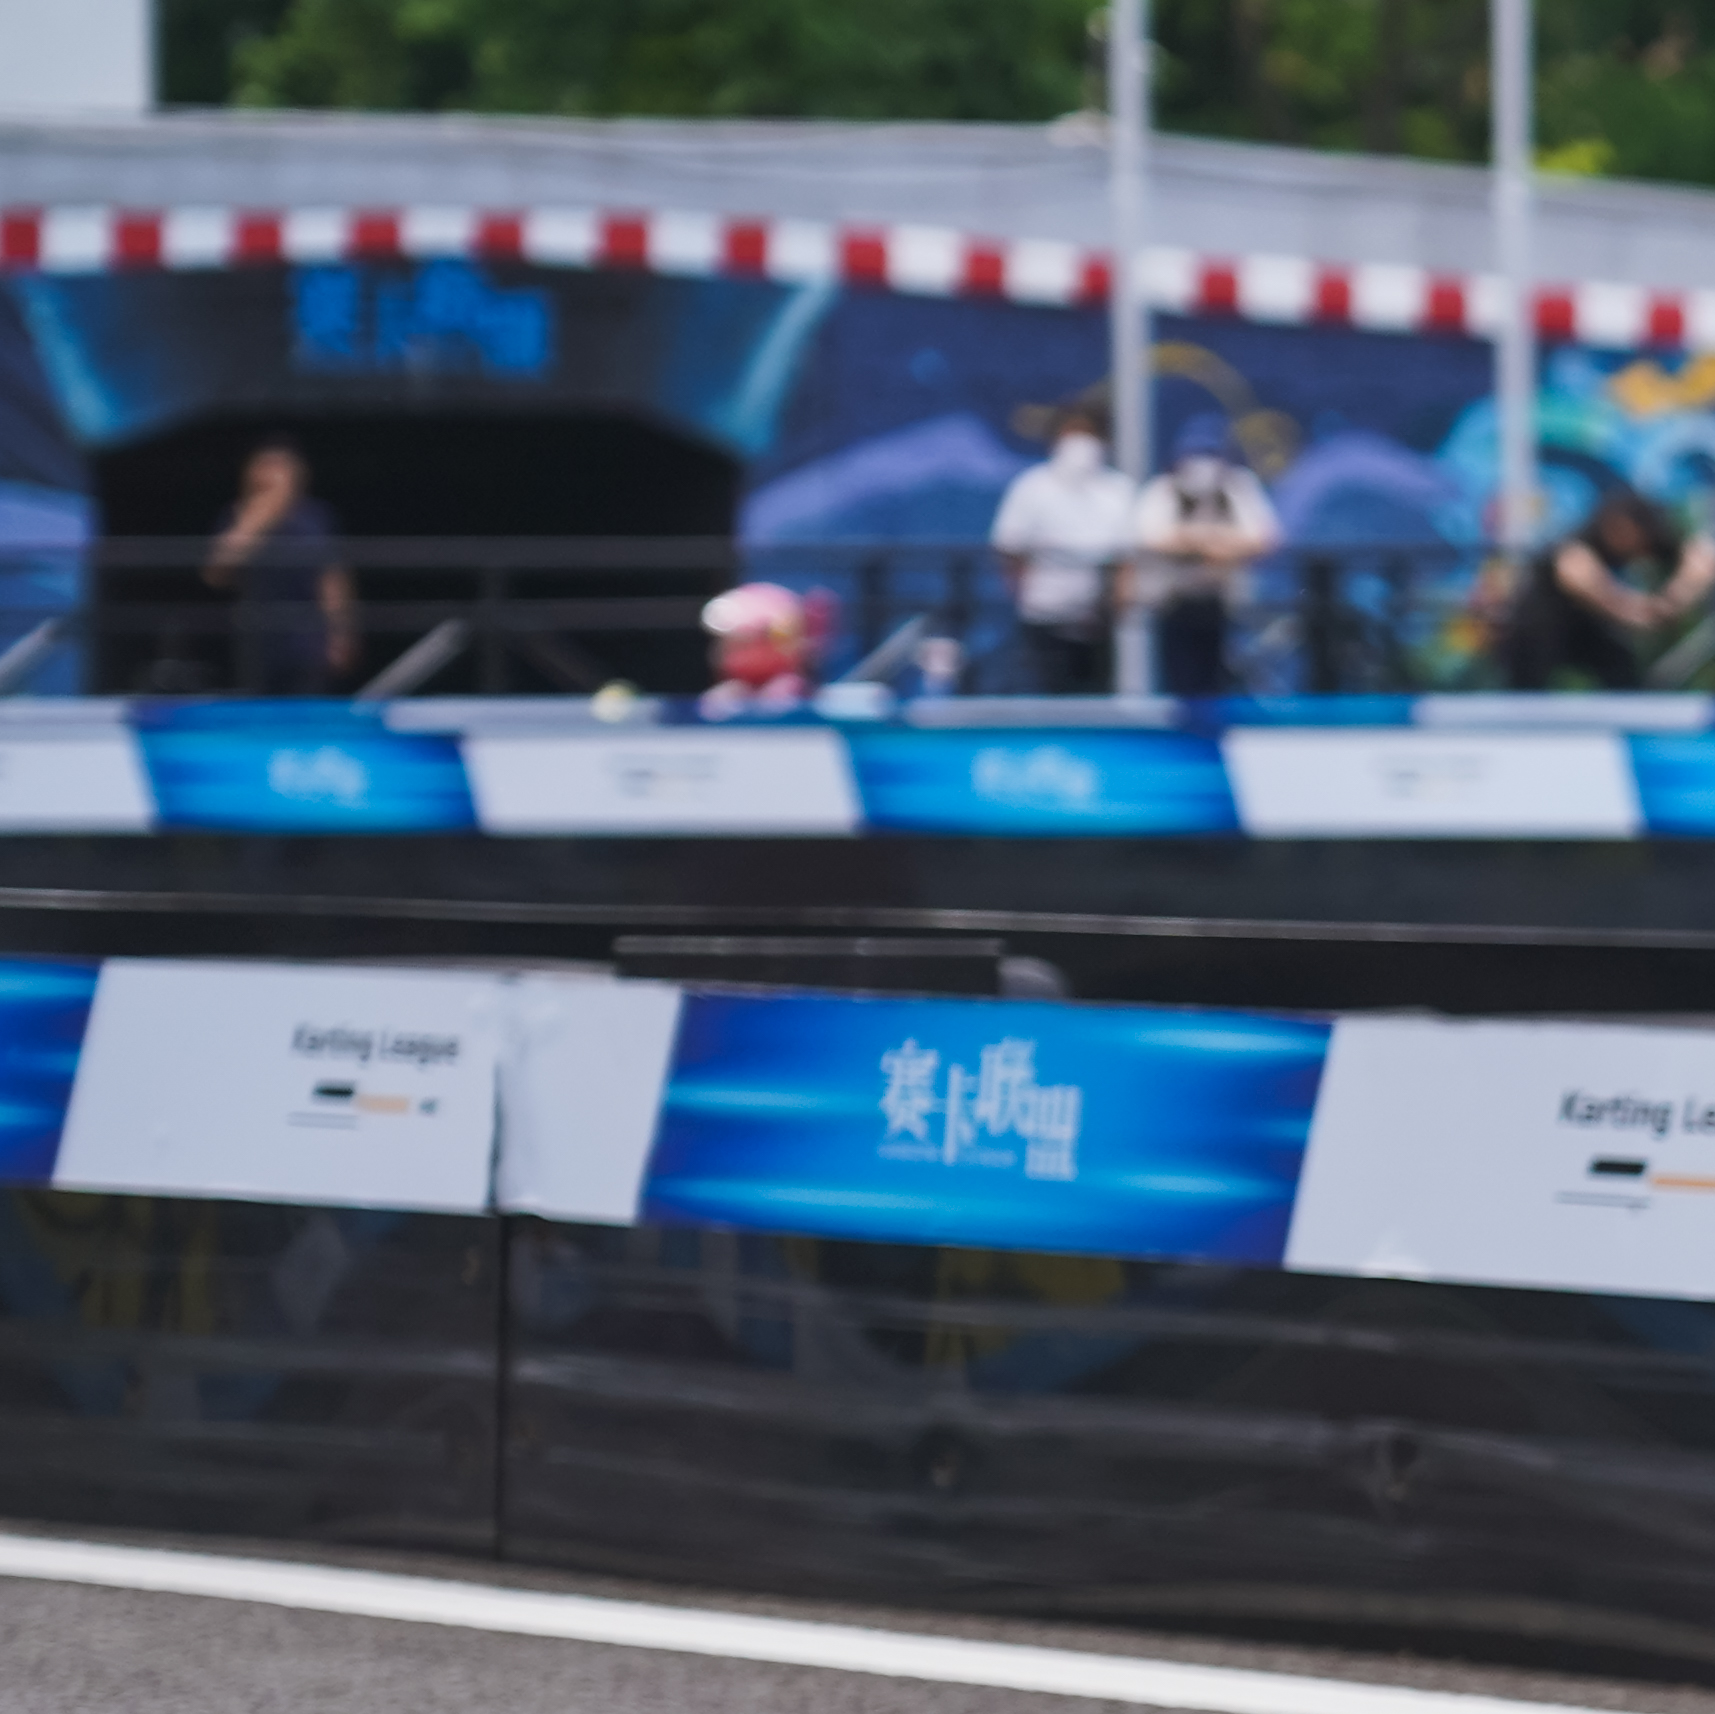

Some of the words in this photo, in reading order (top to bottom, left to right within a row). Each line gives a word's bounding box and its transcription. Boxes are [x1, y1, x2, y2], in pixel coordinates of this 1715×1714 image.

[878, 1037, 1082, 1182] 赛卡联盟
[1557, 1089, 1672, 1141] Karting
